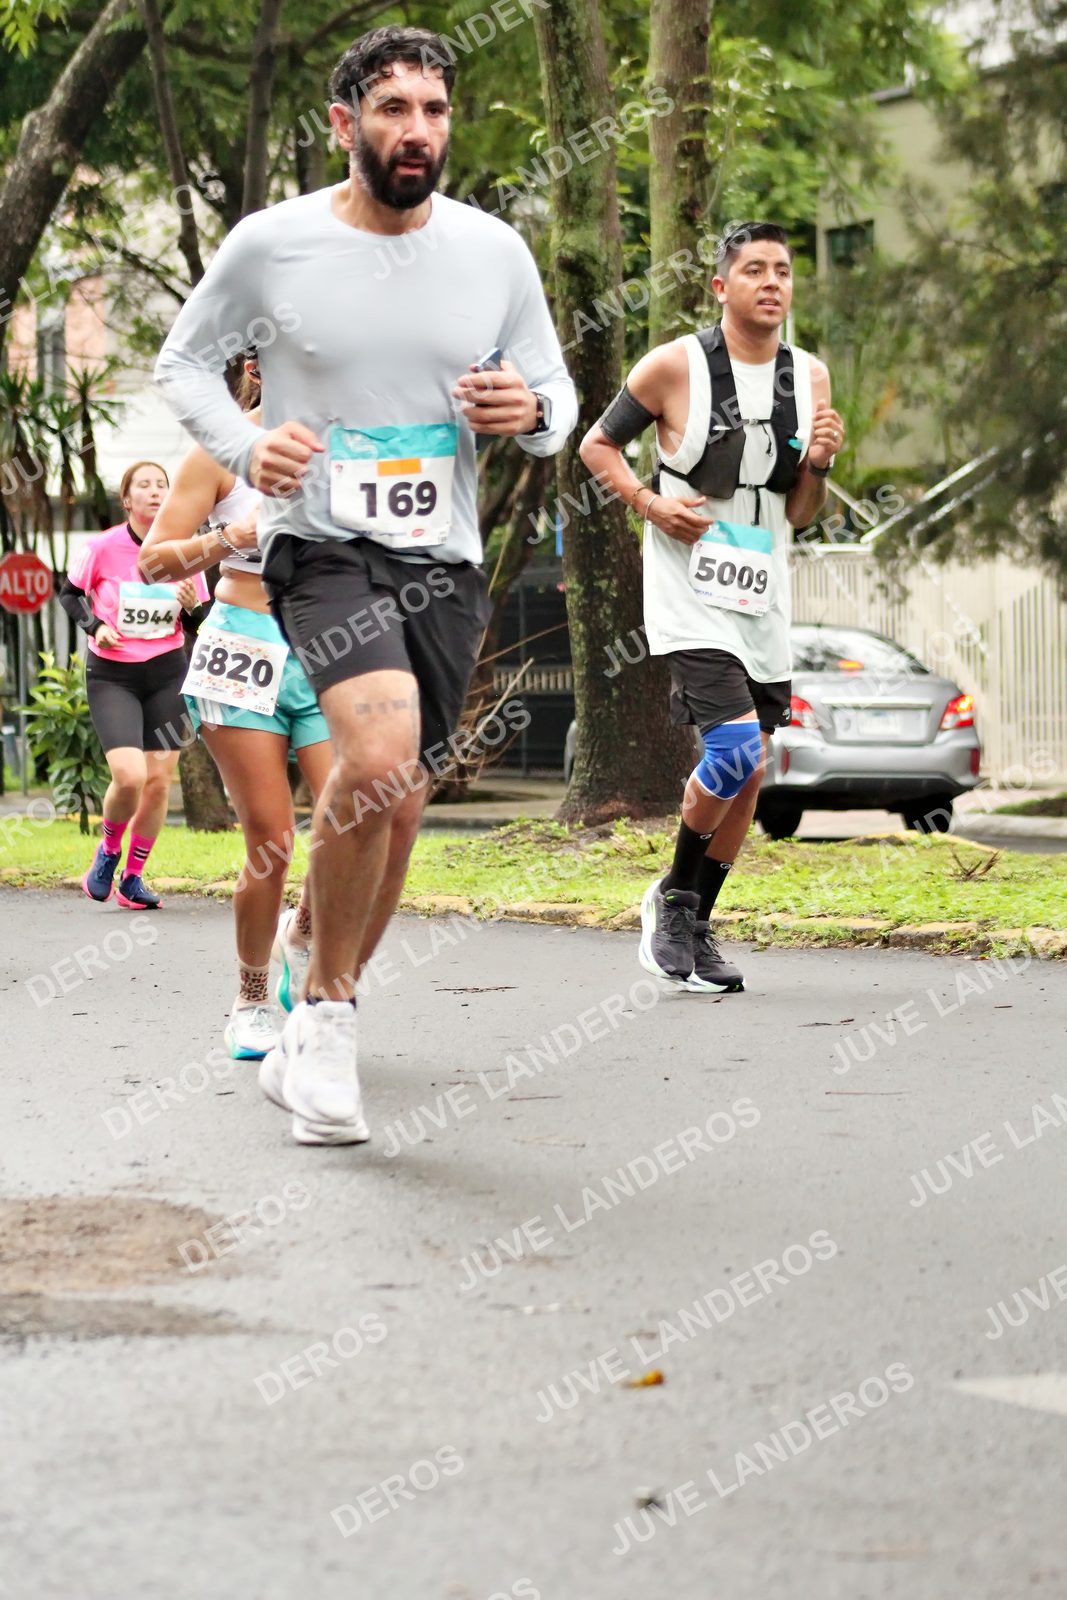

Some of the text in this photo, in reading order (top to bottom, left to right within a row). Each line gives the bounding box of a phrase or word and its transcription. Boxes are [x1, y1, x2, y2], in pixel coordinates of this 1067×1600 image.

[360, 480, 437, 518] 169
[0, 569, 49, 596] ALTO
[694, 556, 768, 595] 5009
[122, 608, 174, 625] 3944
[192, 643, 274, 688] 5820
